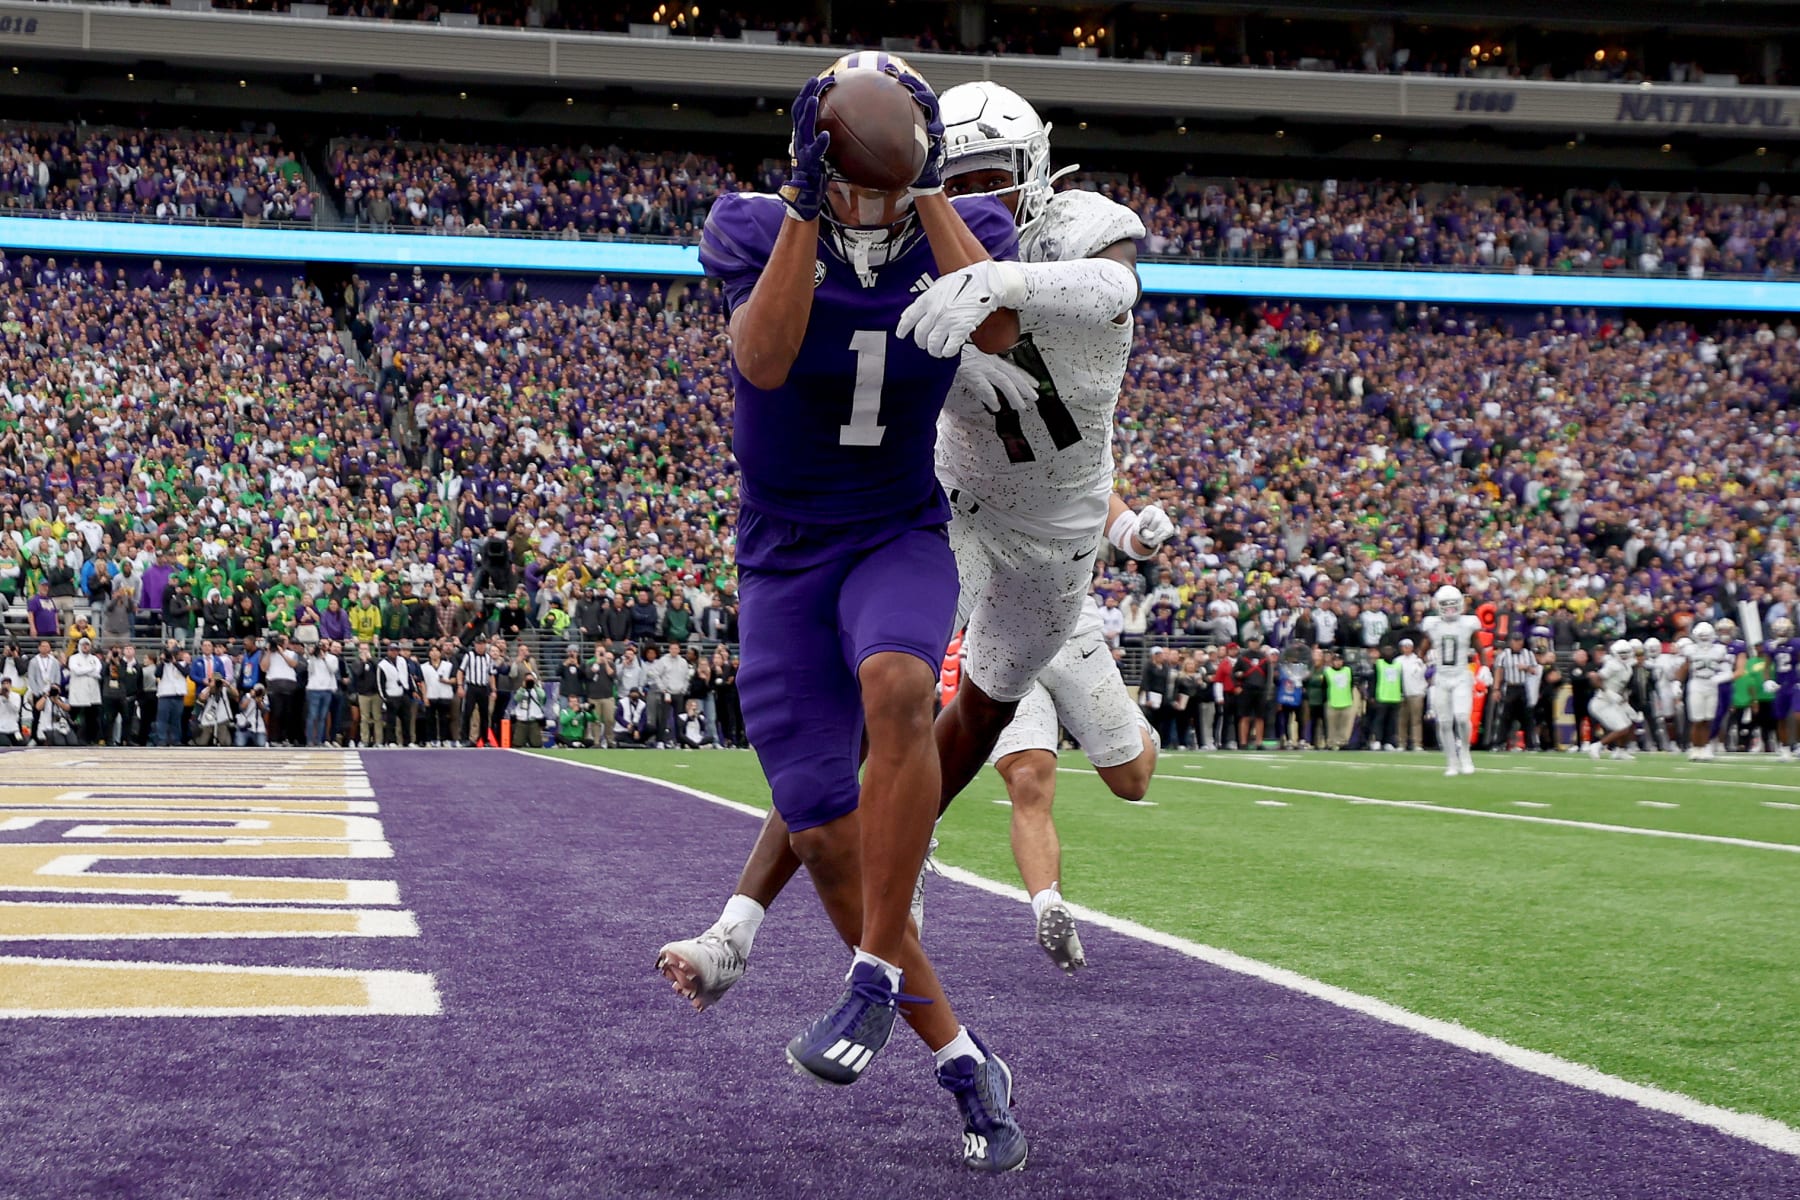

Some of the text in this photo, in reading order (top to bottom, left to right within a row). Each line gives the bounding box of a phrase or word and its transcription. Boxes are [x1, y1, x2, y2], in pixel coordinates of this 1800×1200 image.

[1616, 93, 1791, 126] NATIONAL
[840, 330, 887, 446] 1
[1442, 634, 1458, 666] 0
